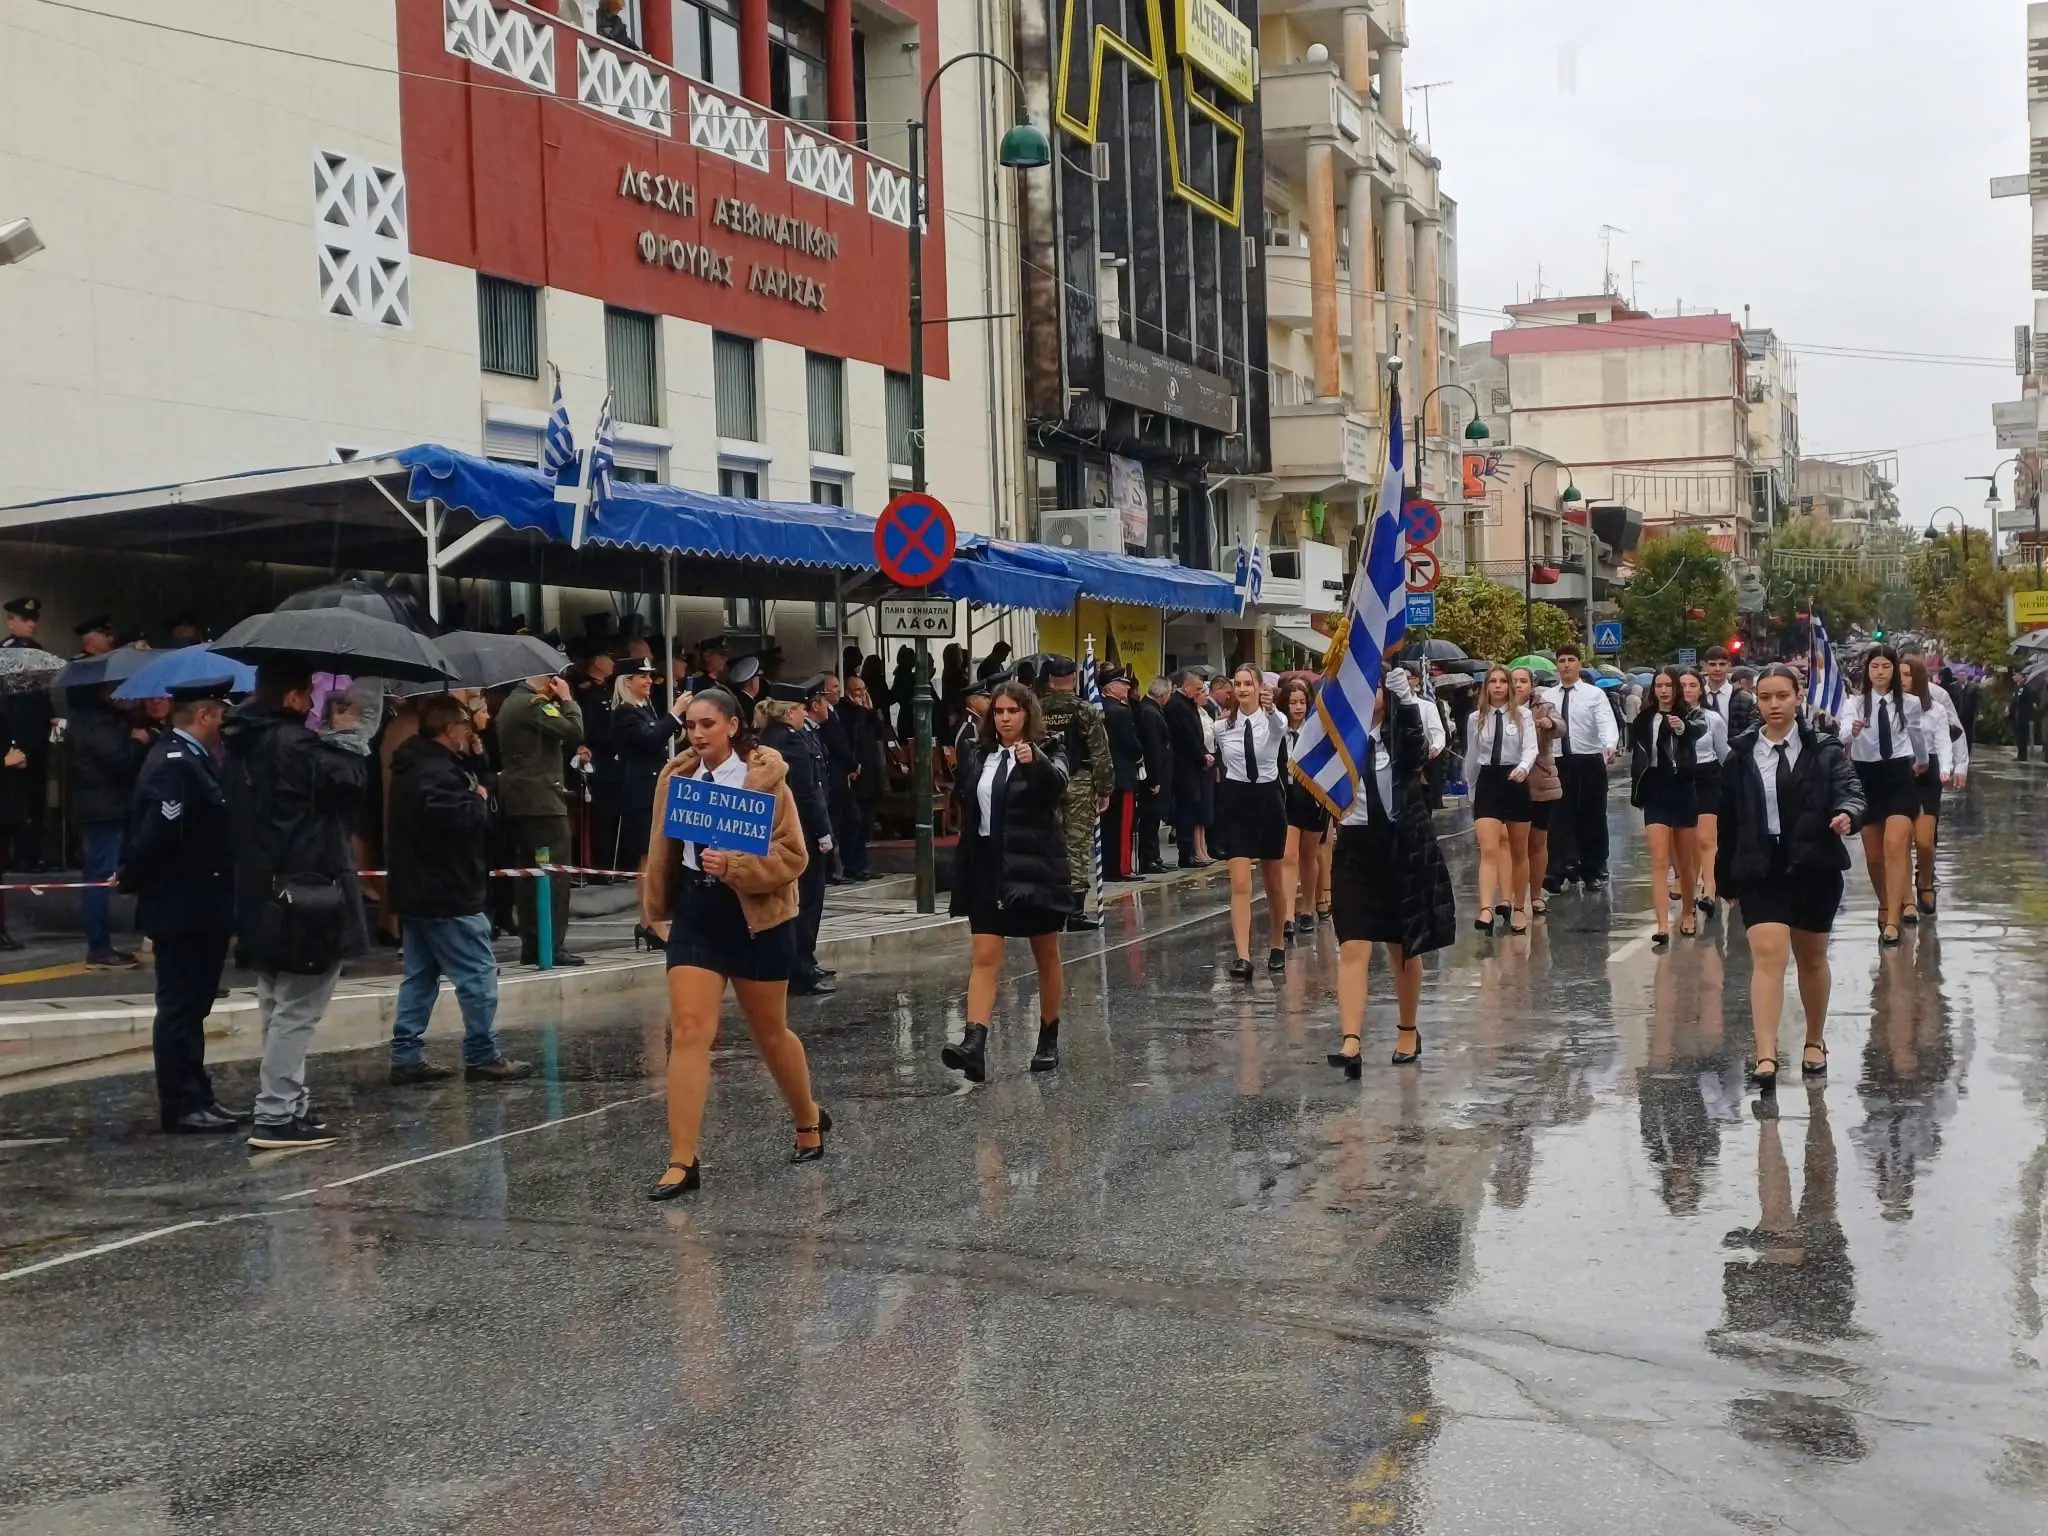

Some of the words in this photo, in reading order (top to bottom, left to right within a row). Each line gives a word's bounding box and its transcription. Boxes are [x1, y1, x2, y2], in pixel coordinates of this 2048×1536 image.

[1191, 0, 1247, 67] ALTERLIFE
[619, 162, 696, 217] ΛΕΣΧΗ
[713, 194, 838, 262] ΑΞΙΩΜΑΤΙΚΩΝ
[638, 230, 734, 288] ΦΡΟΥΡΑΣ
[749, 262, 828, 312] ΛΑΡΙΣΑΣ
[884, 606, 905, 614] ΠΛΗΝ
[906, 606, 949, 615] ΟΧΗΜΑΤΩΝ
[670, 808, 713, 828] ΛΥΚΕΙΟ
[716, 817, 767, 839] ΛΑΡΙΣΑΣ
[709, 791, 766, 815] ΕΝΙΑΙΟ
